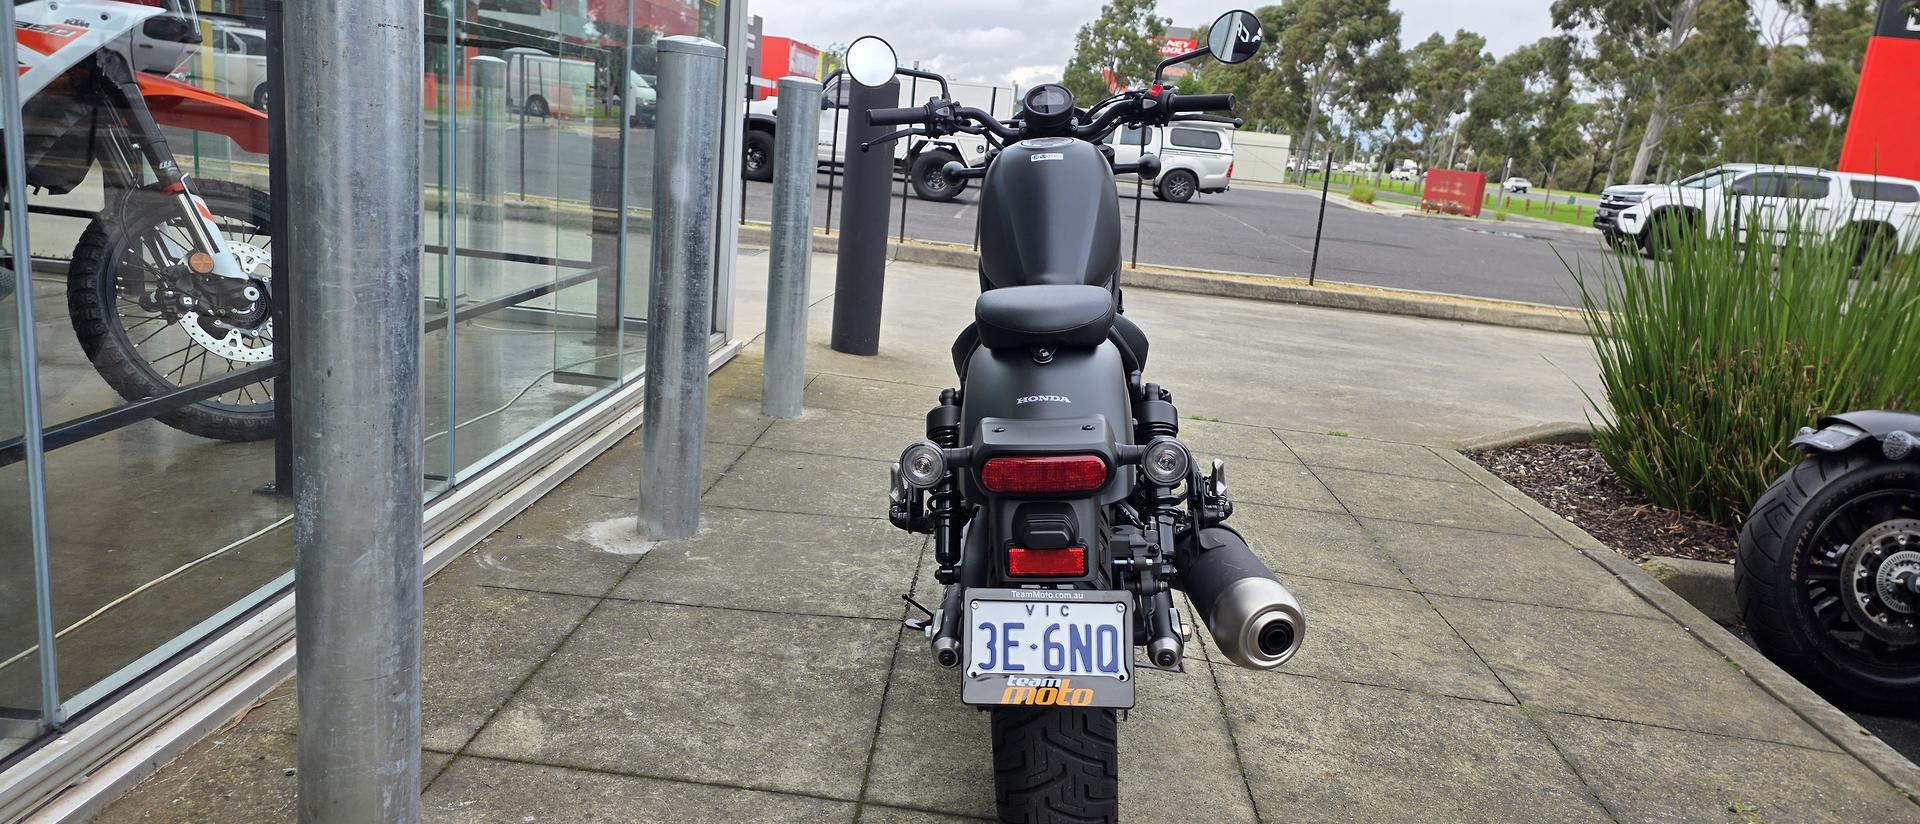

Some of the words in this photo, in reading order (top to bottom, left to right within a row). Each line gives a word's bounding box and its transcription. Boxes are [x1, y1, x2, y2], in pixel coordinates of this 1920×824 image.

[63, 18, 90, 28] KTM
[1016, 395, 1072, 405] HONDA
[1011, 590, 1084, 600] TeamMoto.com.au
[1025, 604, 1070, 617] VIC
[1006, 674, 1062, 688] team
[1000, 678, 1095, 707] moto
